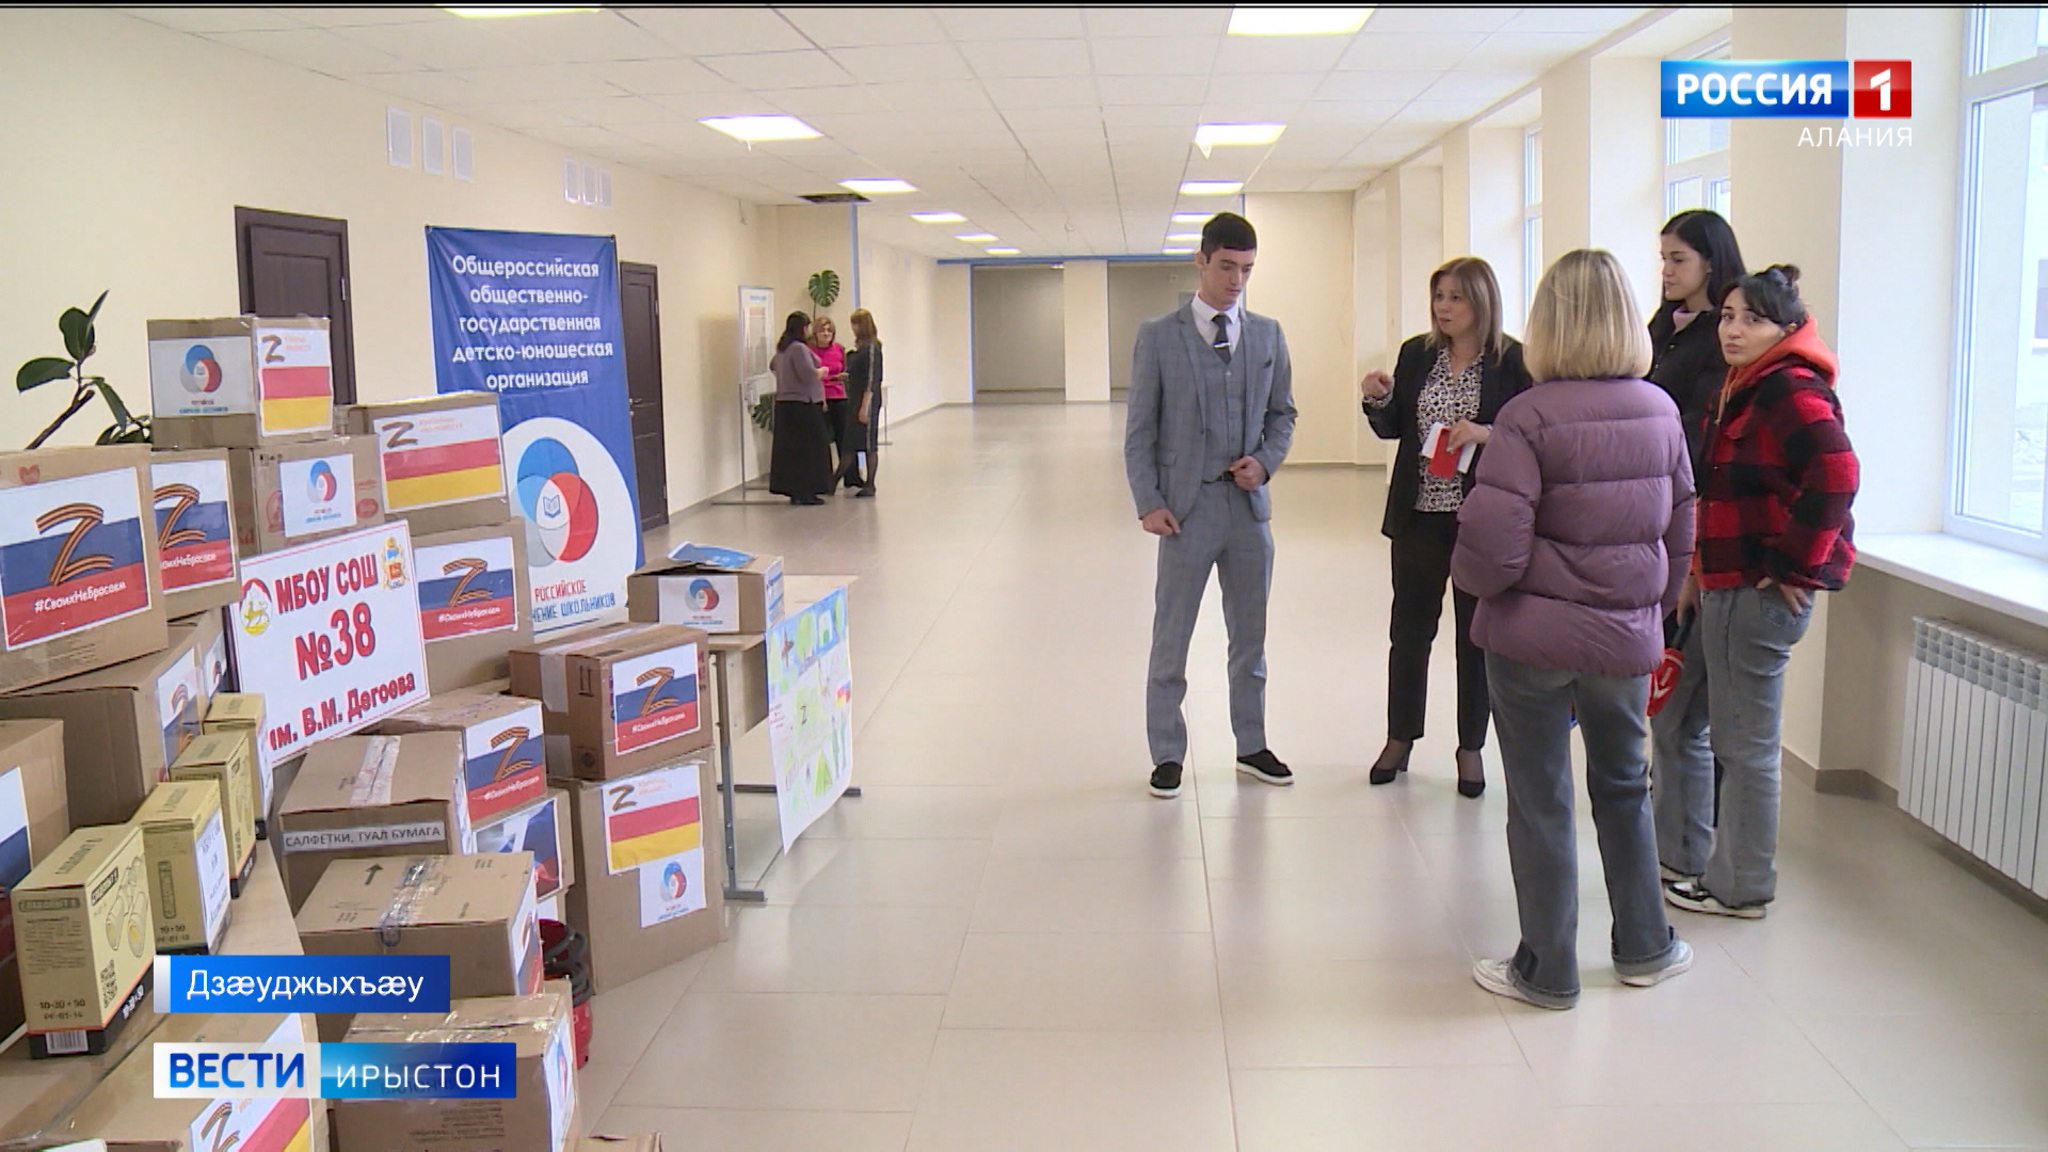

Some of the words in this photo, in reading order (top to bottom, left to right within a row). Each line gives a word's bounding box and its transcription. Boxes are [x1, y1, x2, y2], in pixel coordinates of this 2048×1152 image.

[452, 254, 600, 279] Общероссийская
[469, 284, 589, 304] общественно-
[459, 315, 602, 336] государственная
[452, 342, 614, 363] детско-юношеская
[486, 370, 590, 392] организация
[274, 566, 329, 615] МБОУ
[335, 553, 378, 595] СОШ
[534, 579, 588, 603] РОССИЙСКОЕ
[560, 592, 616, 616] ШКОЛЬНИКОВ
[294, 602, 376, 681] №38
[301, 697, 343, 737] В.М.
[346, 672, 416, 722] Дегоева
[285, 834, 355, 847] САЛФЕТКИ,
[391, 827, 441, 838] БУМАГА
